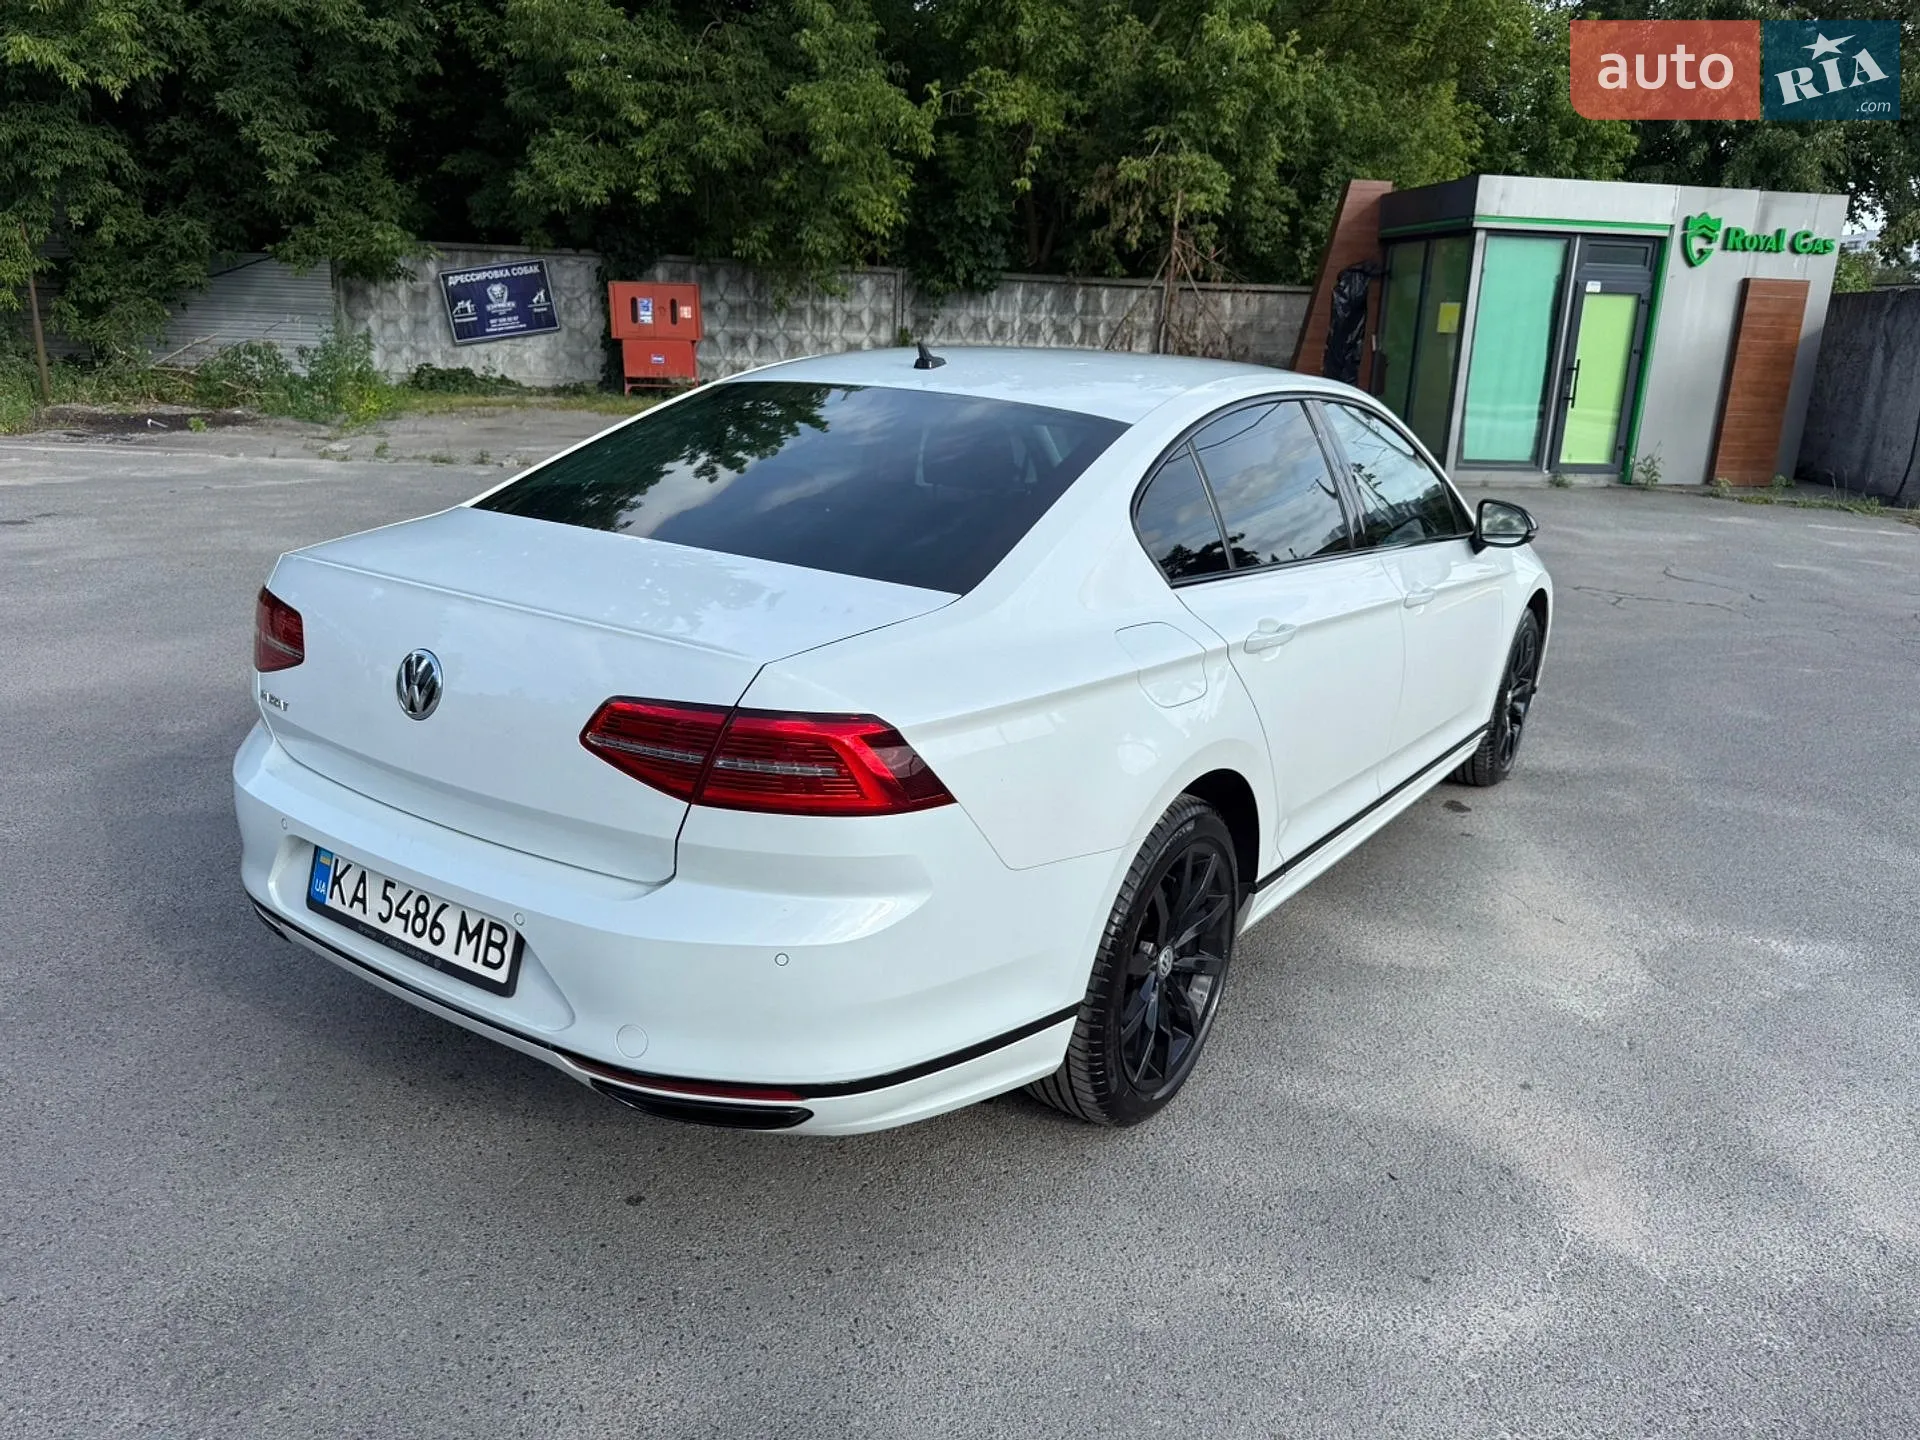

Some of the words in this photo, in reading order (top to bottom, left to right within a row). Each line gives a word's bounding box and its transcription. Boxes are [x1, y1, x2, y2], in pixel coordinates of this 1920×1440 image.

[448, 269, 510, 287] ДРЕССИРОВКА
[510, 265, 540, 277] СОБАК
[397, 649, 443, 720] VW
[314, 878, 327, 895] UA
[329, 858, 370, 915] KA
[377, 880, 450, 946] 5486
[454, 910, 509, 971] MB
